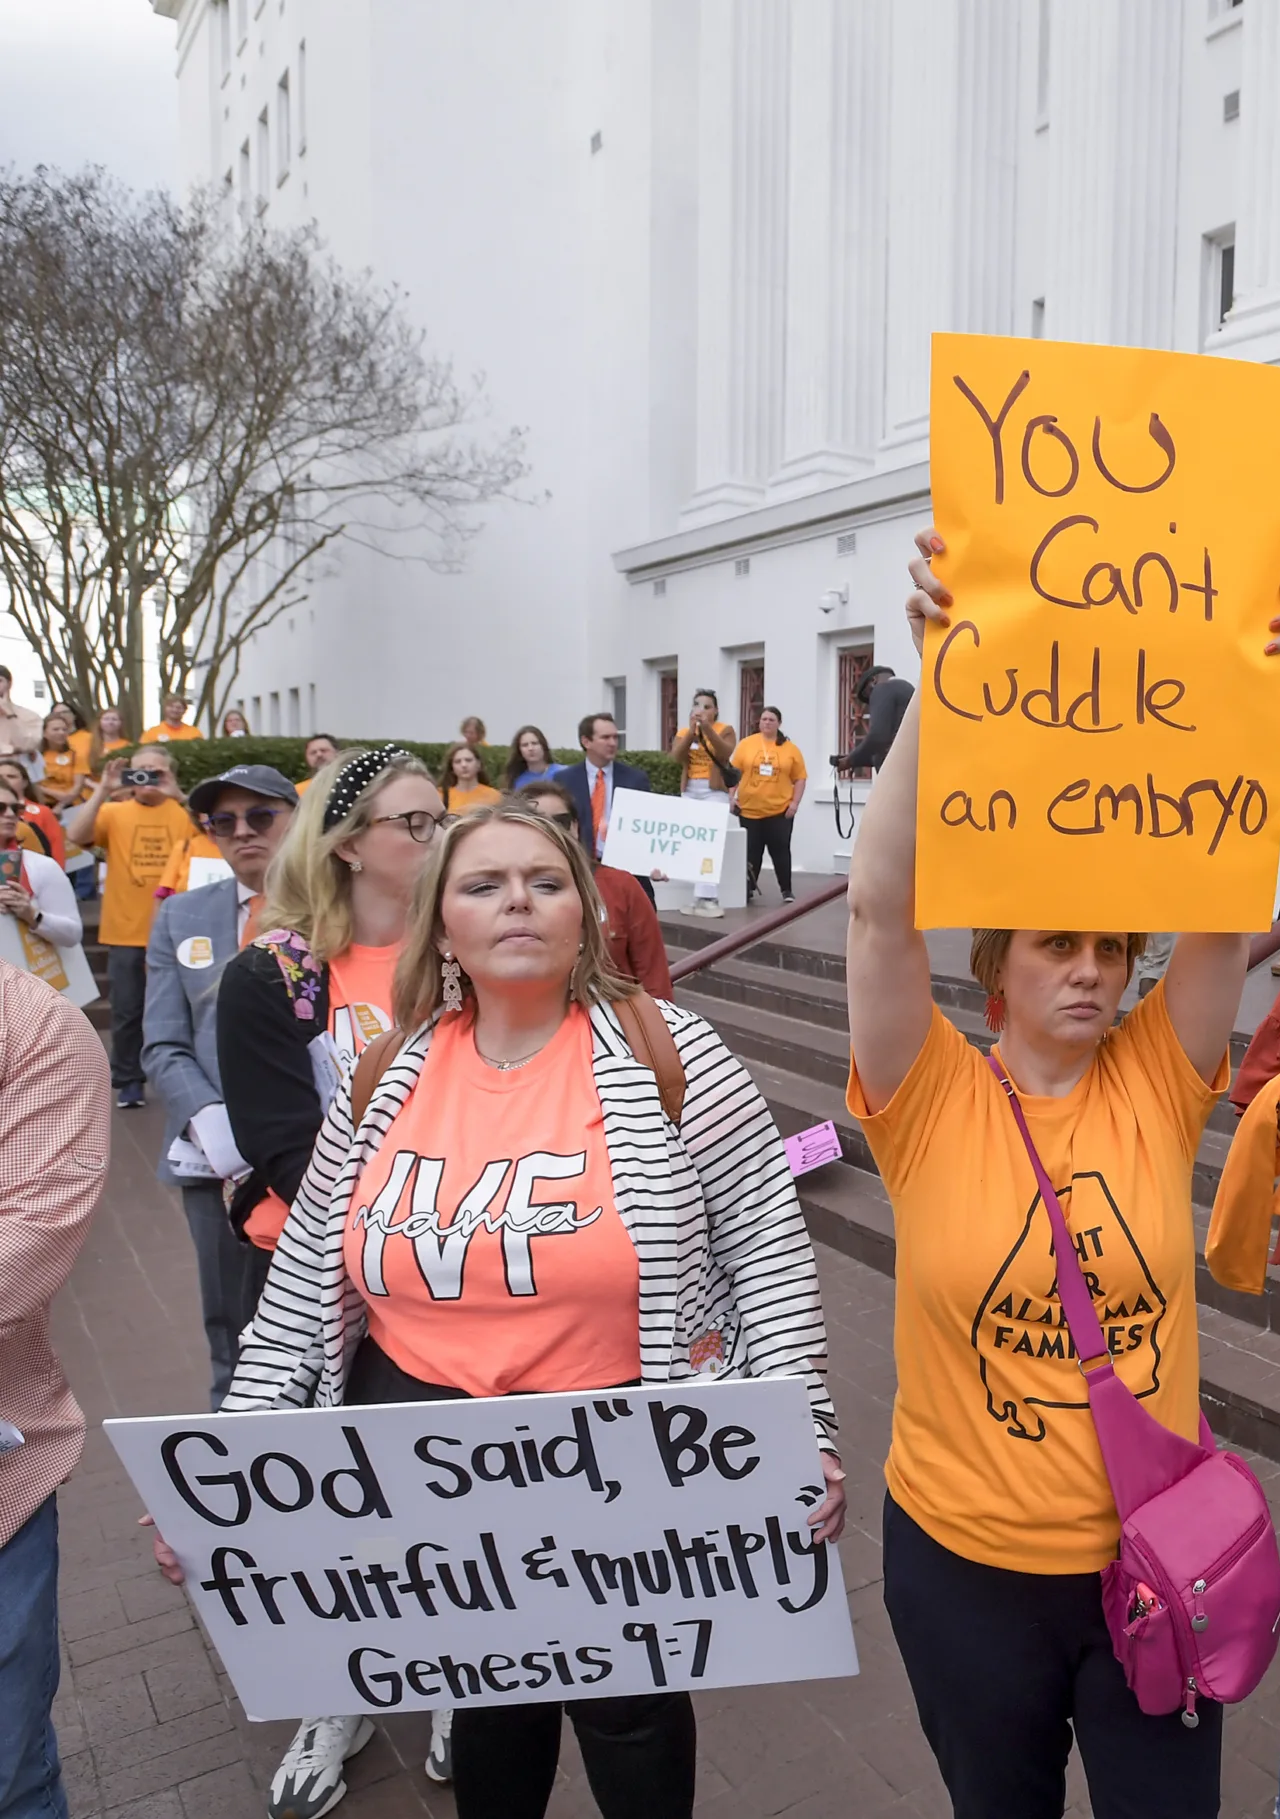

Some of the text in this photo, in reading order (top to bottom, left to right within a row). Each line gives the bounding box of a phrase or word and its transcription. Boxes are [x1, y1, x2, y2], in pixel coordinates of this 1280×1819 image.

[933, 619, 1197, 734] Cuddle
[617, 816, 719, 843] I SUPPORT
[649, 838, 683, 856] IVF
[939, 772, 1269, 856] an embryo
[361, 1149, 588, 1301] IVF
[159, 1425, 394, 1528] God
[200, 1532, 516, 1627] fruitful
